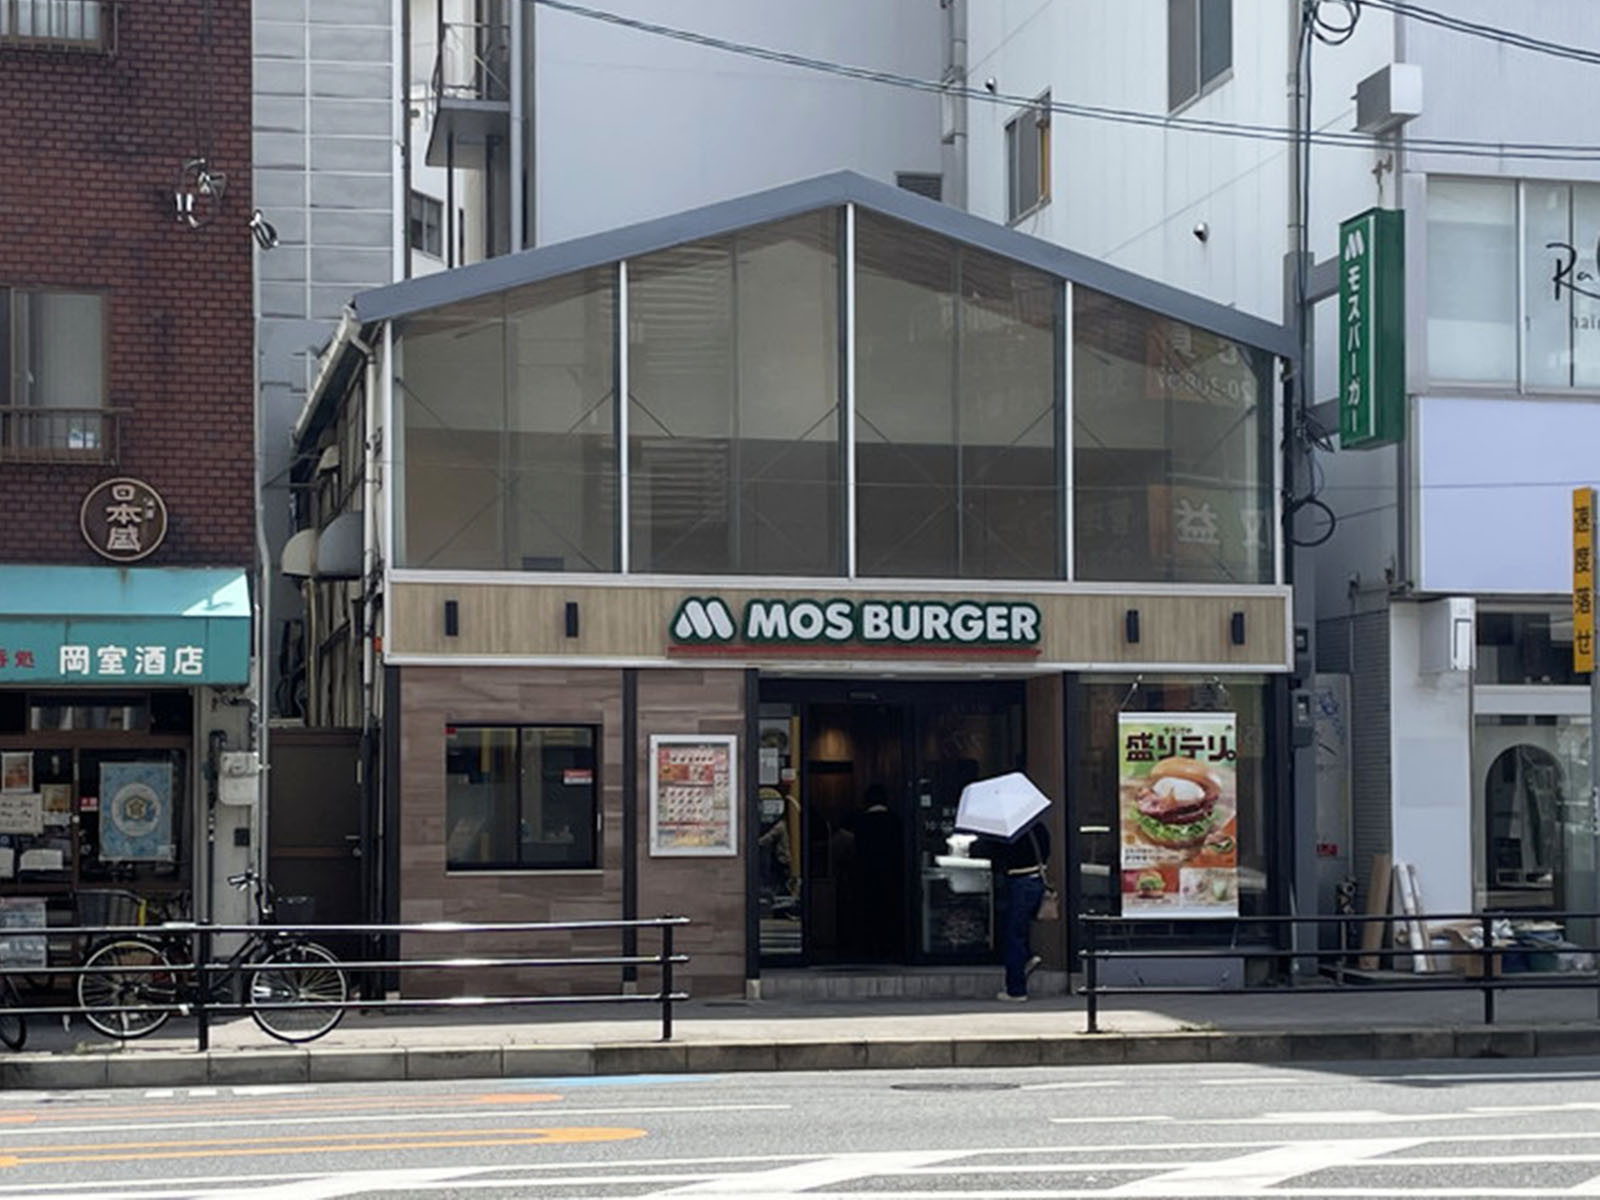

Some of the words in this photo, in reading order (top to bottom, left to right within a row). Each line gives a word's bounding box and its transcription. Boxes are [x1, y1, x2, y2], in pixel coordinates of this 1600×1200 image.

[1347, 266, 1362, 433] モスバーガー
[105, 484, 142, 552] 日本盛
[747, 602, 853, 639] MOS
[863, 604, 1037, 641] BURGER
[59, 645, 204, 675] 岡室酒店
